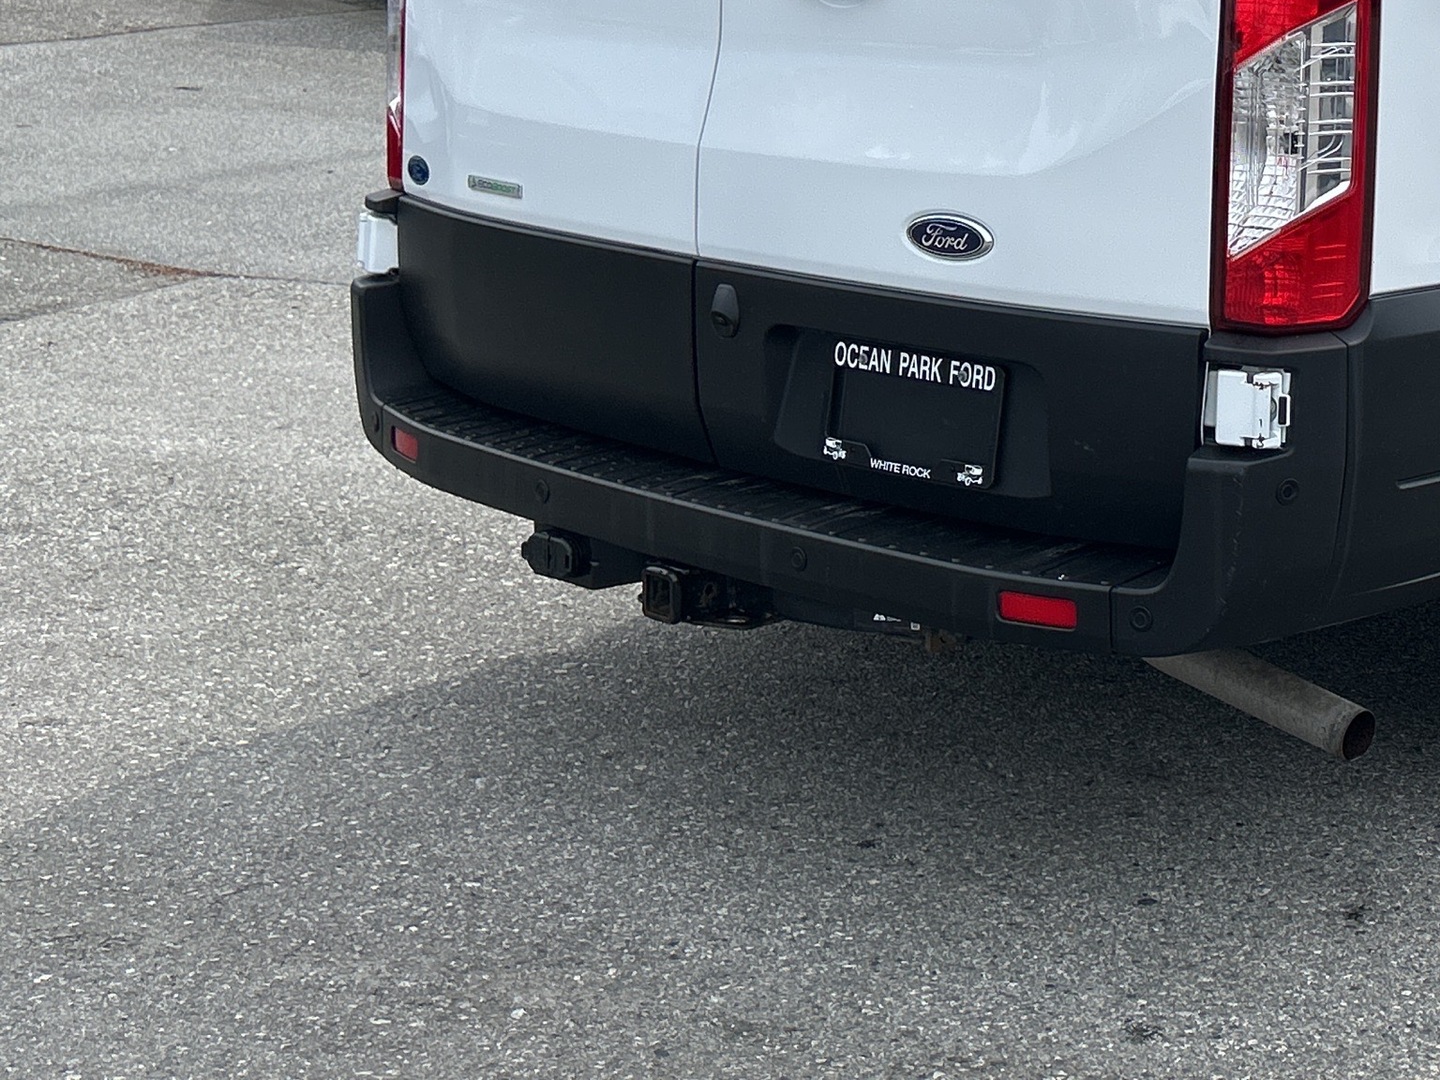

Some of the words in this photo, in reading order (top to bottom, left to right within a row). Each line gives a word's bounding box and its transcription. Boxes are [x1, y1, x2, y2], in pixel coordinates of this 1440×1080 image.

[921, 223, 969, 251] Ford
[834, 341, 892, 374] OCEAN
[898, 352, 943, 383] PARK
[949, 360, 996, 391] FORD
[870, 457, 901, 474] WHITE
[901, 464, 931, 479] ROCK
